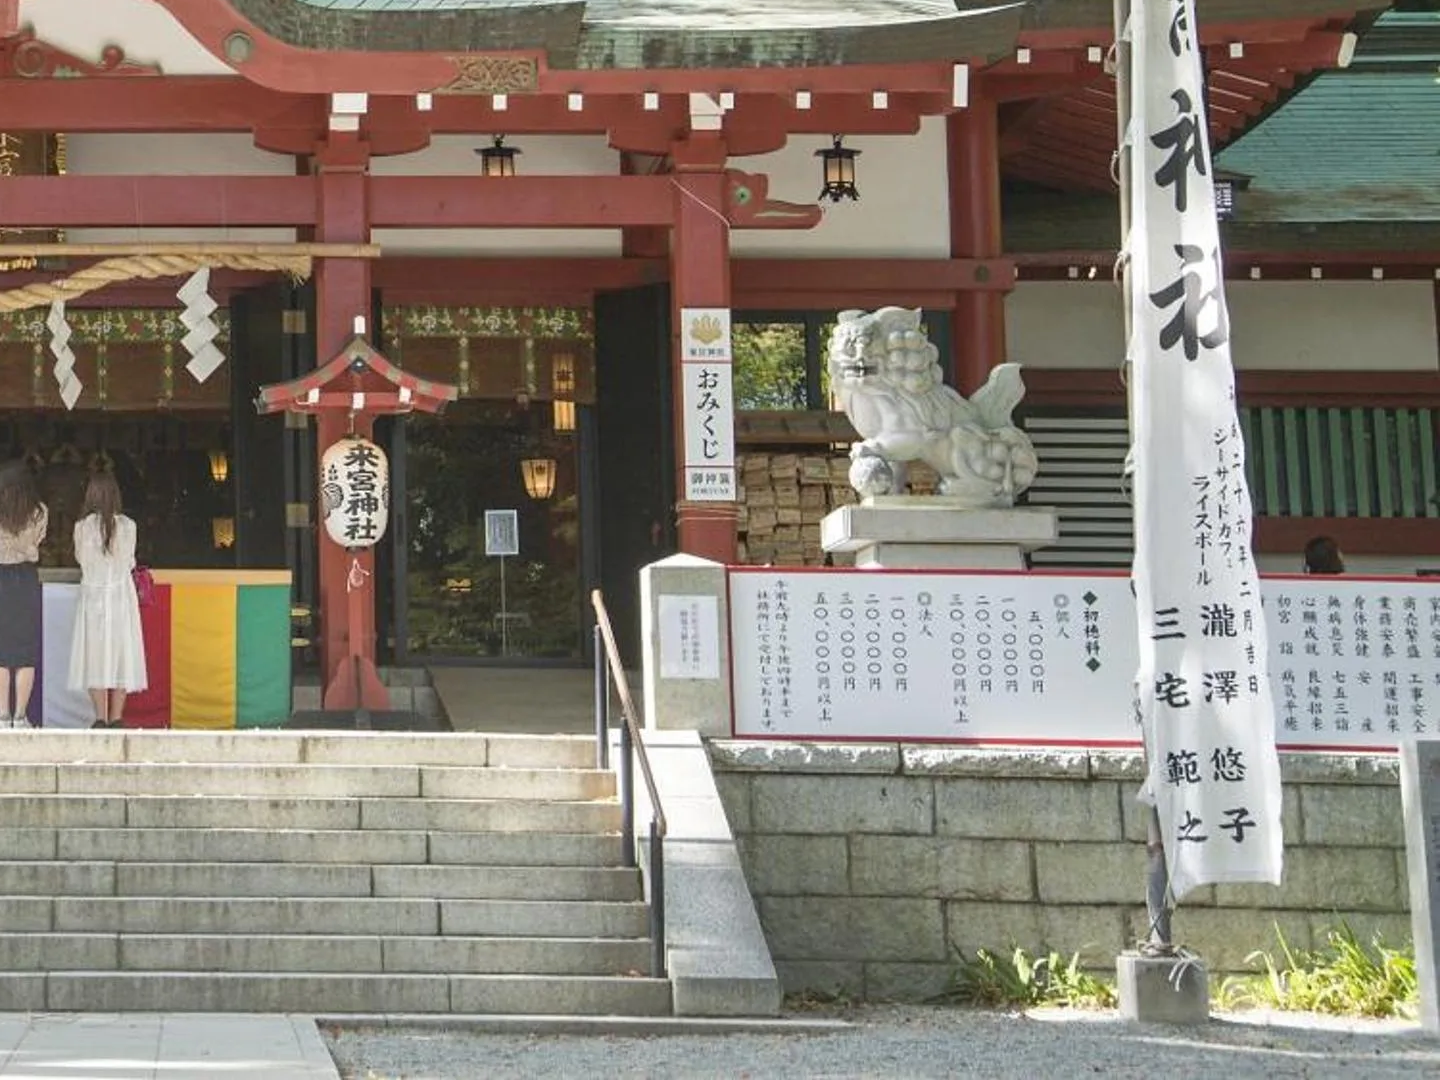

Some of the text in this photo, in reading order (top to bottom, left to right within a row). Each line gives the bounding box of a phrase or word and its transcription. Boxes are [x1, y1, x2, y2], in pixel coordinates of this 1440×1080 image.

[696, 368, 721, 460] おみくじ
[343, 443, 380, 541] 来宮神社
[1192, 475, 1213, 586] ライスボール
[1213, 428, 1233, 568] シーサイドカフェ
[1301, 597, 1319, 656] 心願成就
[1151, 607, 1210, 844] 三宅範之
[1201, 604, 1257, 843] 瀧澤悠子
